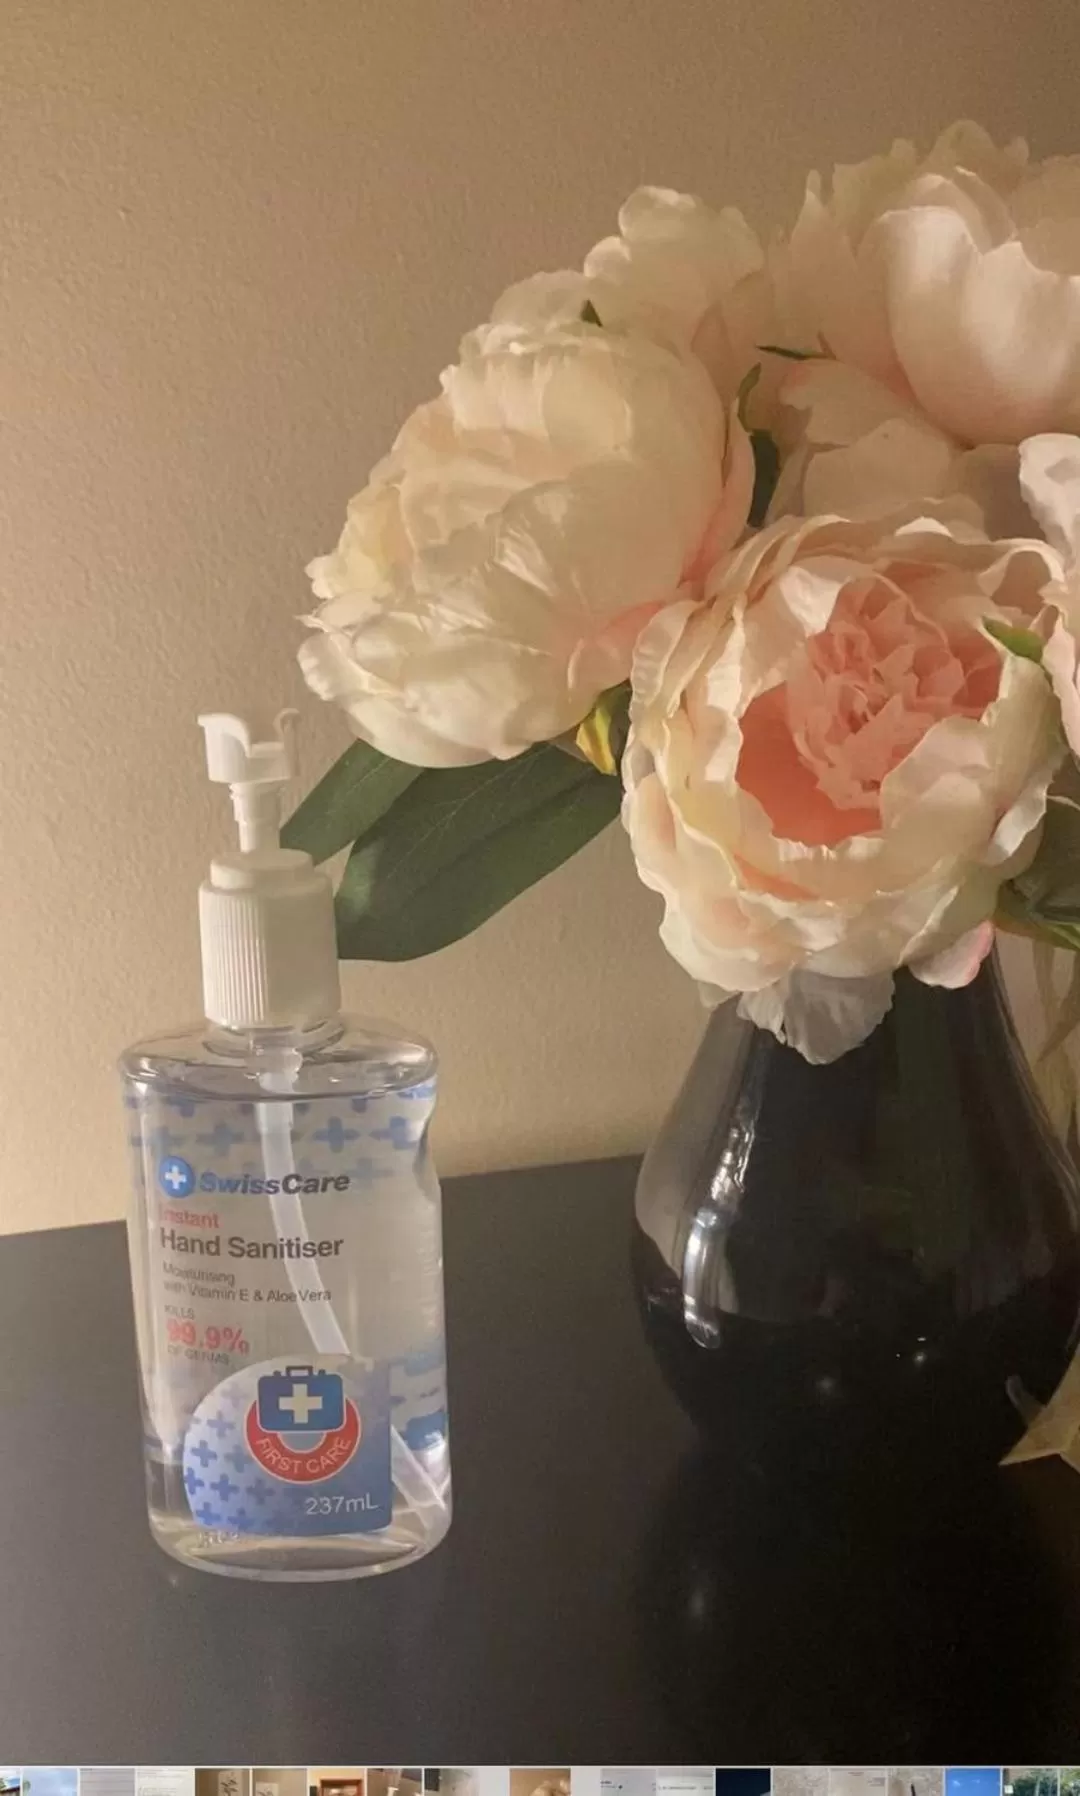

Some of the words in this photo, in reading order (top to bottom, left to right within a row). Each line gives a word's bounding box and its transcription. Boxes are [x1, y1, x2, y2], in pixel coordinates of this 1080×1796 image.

[200, 1171, 350, 1195] SwissCare
[159, 1205, 220, 1229] Instant
[160, 1227, 221, 1257] Hand
[228, 1236, 344, 1259] Sanitiser
[188, 1283, 237, 1301] Vitamin
[239, 1289, 249, 1301] E
[253, 1290, 263, 1302] &
[266, 1289, 297, 1302] Aloe
[298, 1288, 332, 1301] Vera
[166, 1318, 249, 1355] 99.9%
[255, 1438, 301, 1474] FIRST
[305, 1436, 352, 1474] CARE
[305, 1493, 379, 1516] 237mL
